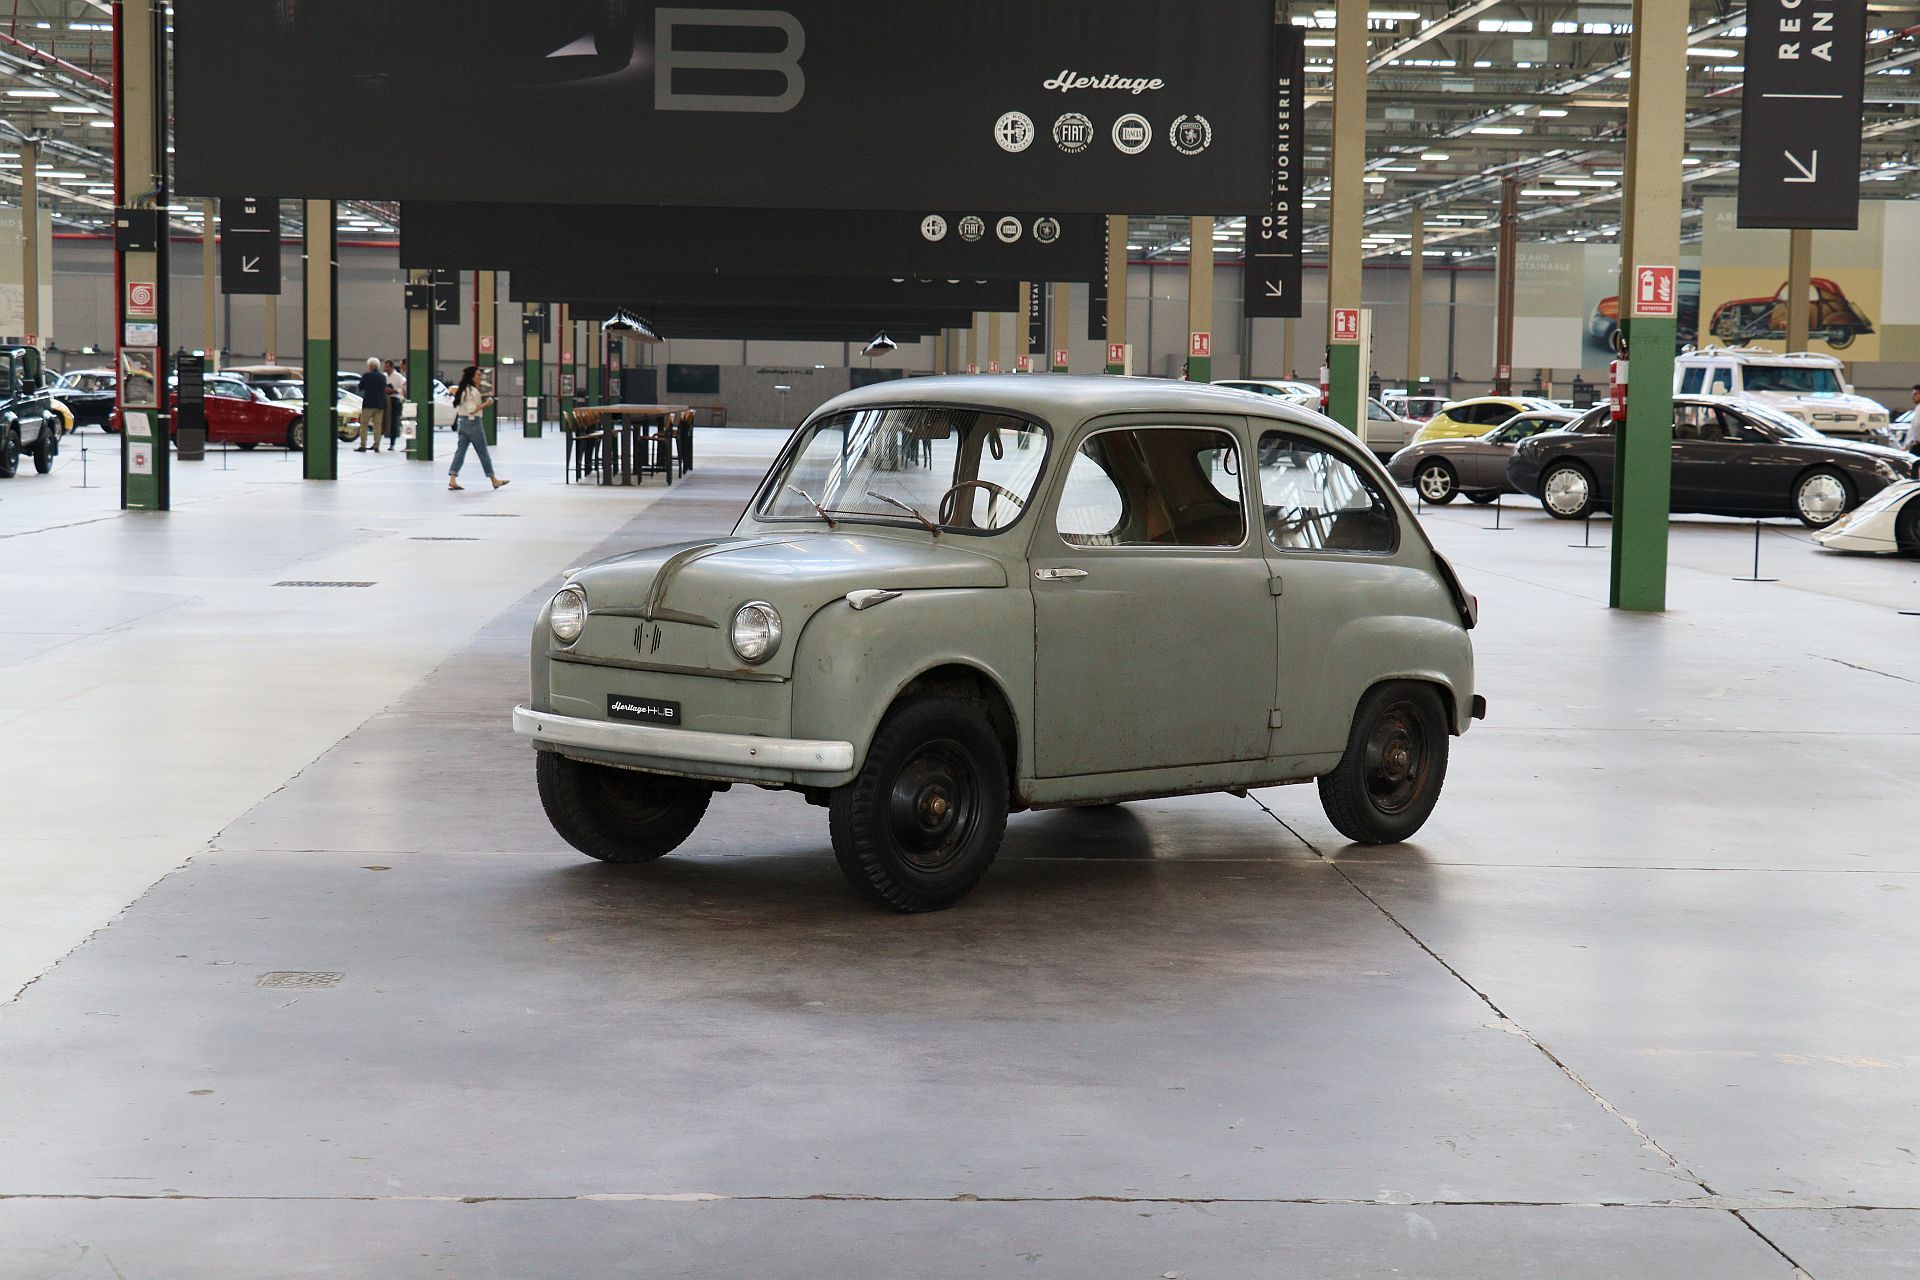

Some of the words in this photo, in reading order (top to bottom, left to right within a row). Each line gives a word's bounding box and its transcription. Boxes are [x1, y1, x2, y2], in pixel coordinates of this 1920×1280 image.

[1811, 0, 1834, 62] AN
[655, 8, 805, 113] B
[1043, 70, 1165, 95] Heritage
[1062, 125, 1084, 142] FIAT
[1278, 78, 1290, 191] FUORISERIE
[965, 223, 979, 234] FIAT
[1277, 201, 1289, 239] AND
[611, 700, 647, 714] Heritage
[647, 705, 674, 717] HUB
